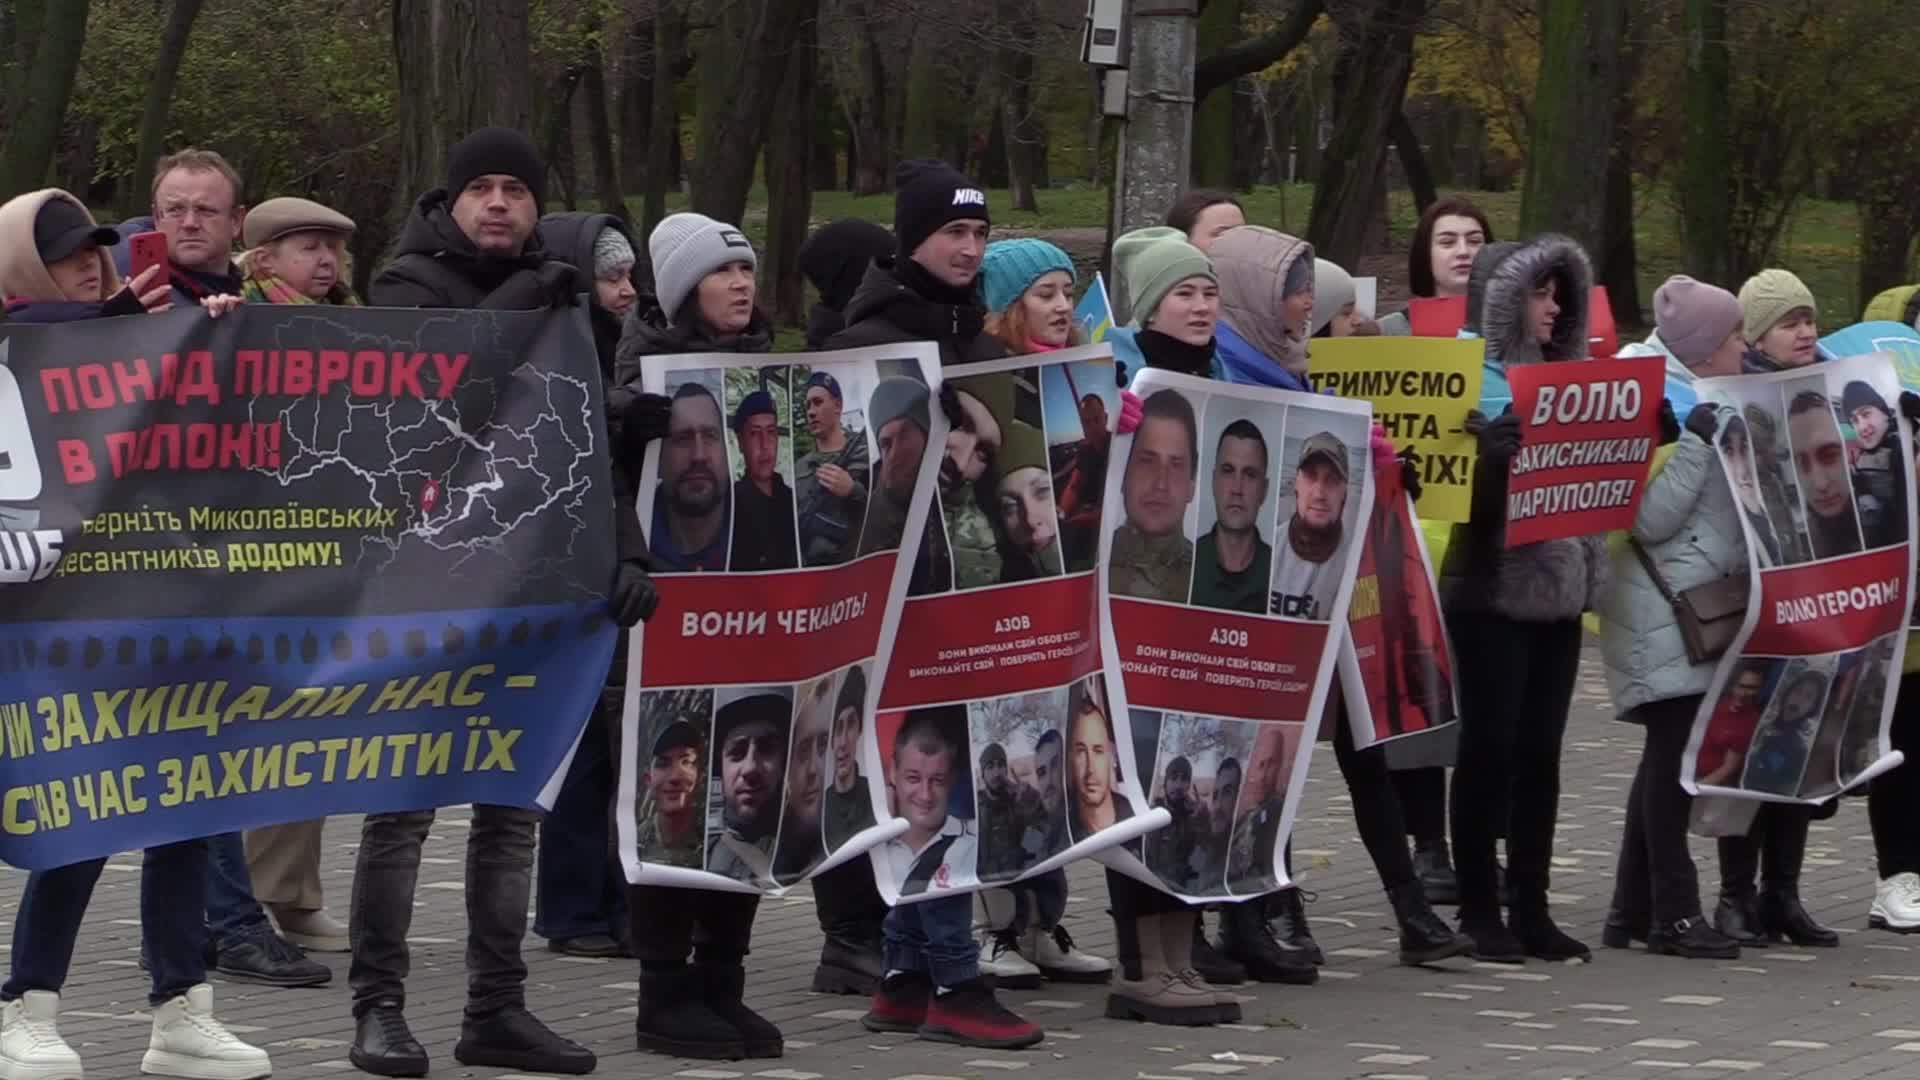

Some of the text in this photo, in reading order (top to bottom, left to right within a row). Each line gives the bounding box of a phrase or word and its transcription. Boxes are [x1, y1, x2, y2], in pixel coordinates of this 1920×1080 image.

[952, 189, 984, 205] NIKE
[234, 350, 470, 398] ПІВРОКУ
[1531, 379, 1641, 425] ВОЛЮ
[58, 439, 97, 484] В
[189, 501, 398, 531] Миколаївських
[1508, 479, 1636, 521] МАРІУПОЛЯ!
[227, 542, 342, 572] ДОДОМУ!
[681, 592, 868, 637] ВОНИ ЧЕКАЮТЬ!
[1776, 577, 1899, 625] ВОЛЮ ГЕРОЯМ!
[994, 615, 1031, 633] АЗОВ
[1209, 628, 1248, 647] АЗОВ
[909, 661, 972, 678] ВИКОНАЙТЕ
[938, 650, 967, 661] ВОНИ
[1136, 645, 1168, 658] ВОНИ
[37, 679, 368, 752] ЗАХИЩАЛИ
[367, 663, 495, 714] НАС
[72, 764, 147, 821] ЧАС
[157, 731, 453, 808] ЗАХИСТИТИ
[463, 716, 524, 772] ЇХ
